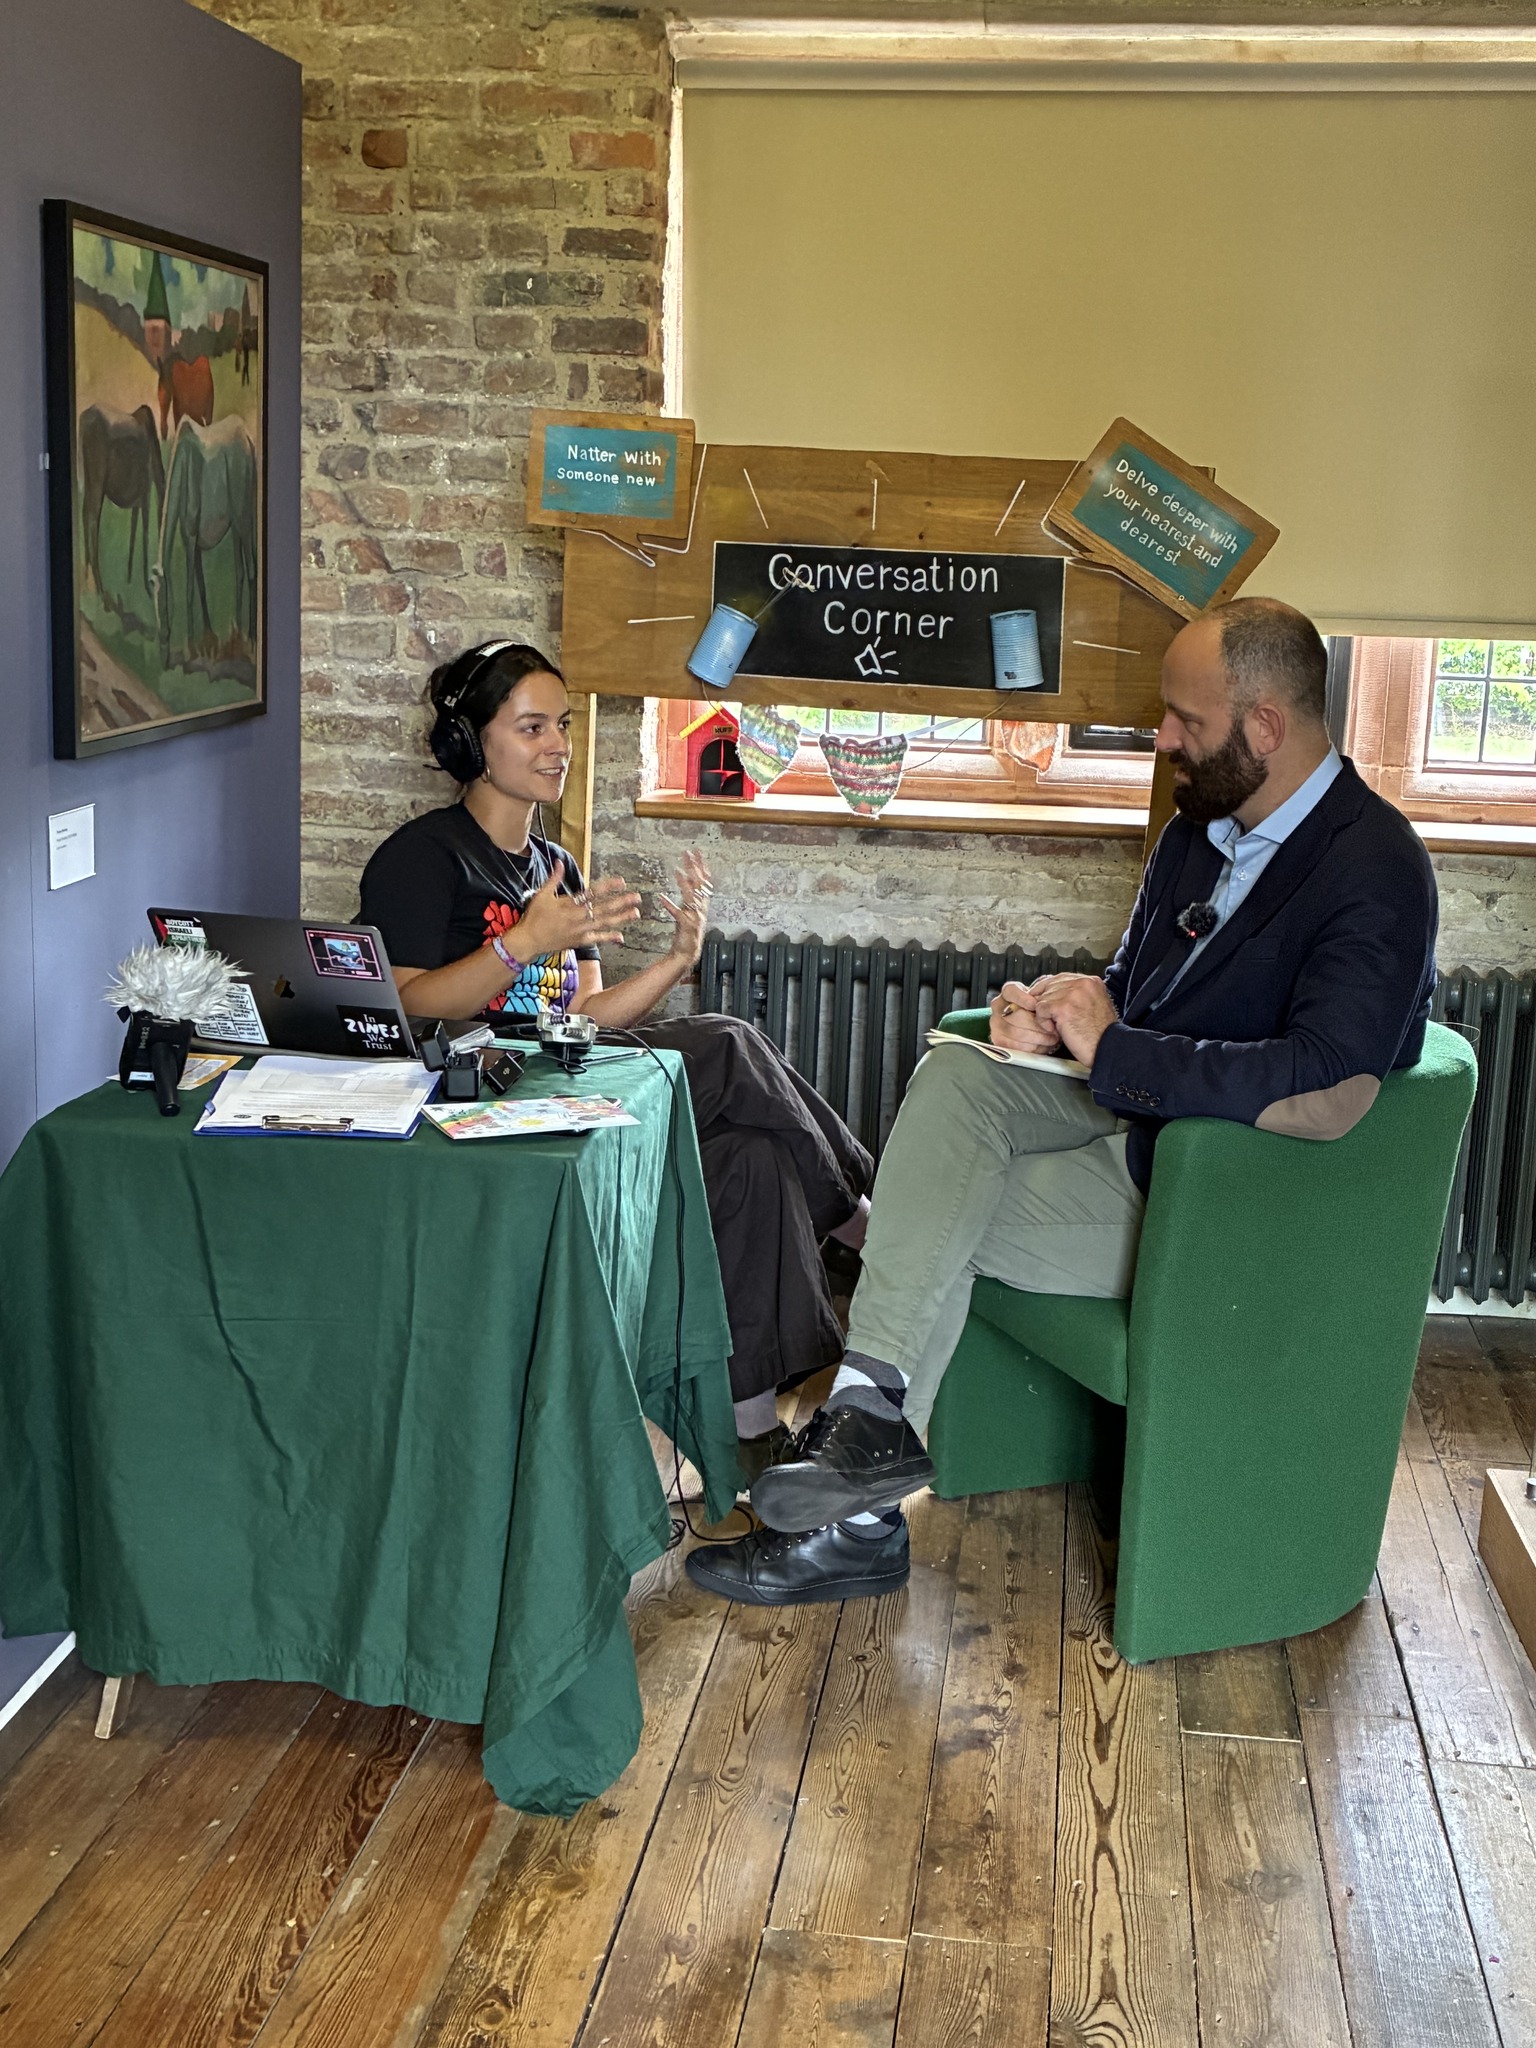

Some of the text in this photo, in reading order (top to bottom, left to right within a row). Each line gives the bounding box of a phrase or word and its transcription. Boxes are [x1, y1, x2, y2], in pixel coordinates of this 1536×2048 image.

[567, 444, 617, 463] Natter
[626, 474, 656, 487] new
[1115, 458, 1238, 554] Delve deeper with
[1103, 483, 1223, 568] your nearest and
[1120, 517, 1181, 566] dearest
[768, 553, 999, 593] Conversation
[823, 600, 954, 639] Corner
[343, 1018, 400, 1039] ZINES
[363, 1013, 376, 1023] In
[362, 1039, 393, 1050] Trust
[367, 1033, 385, 1043] We
